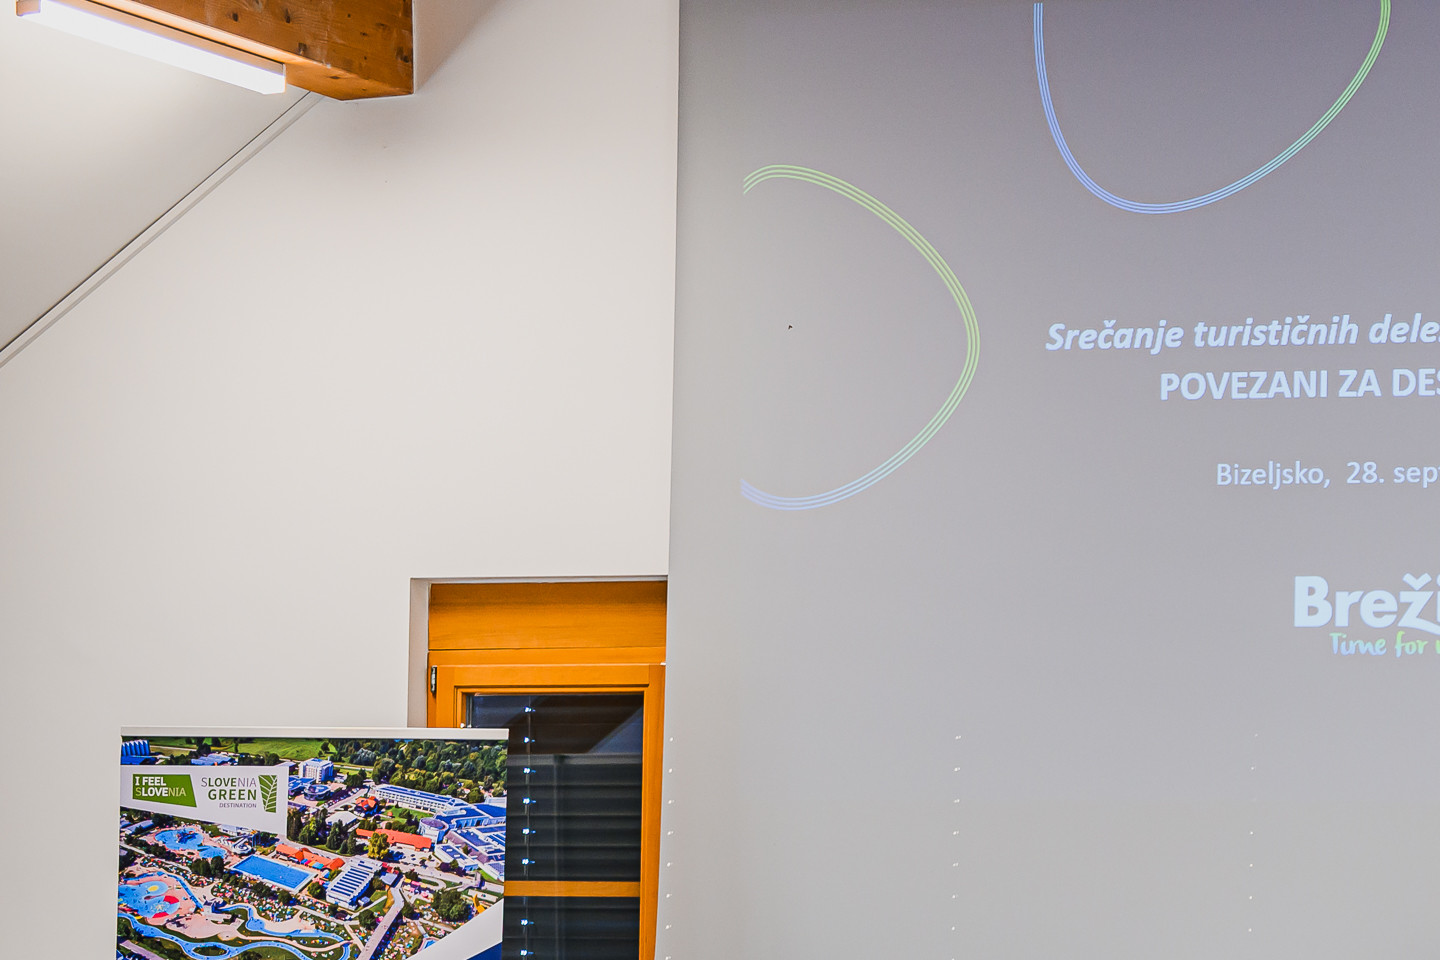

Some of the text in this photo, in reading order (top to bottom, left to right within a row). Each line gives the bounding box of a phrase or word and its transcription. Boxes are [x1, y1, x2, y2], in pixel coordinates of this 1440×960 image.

[1045, 319, 1185, 356] Srečanje
[1194, 314, 1360, 348] turističnih
[1159, 369, 1328, 401] POVEZANI
[1338, 368, 1382, 398] ZA
[1216, 460, 1332, 491] Bizeljsko,
[1345, 461, 1385, 485] 28.
[1329, 632, 1388, 656] Time
[1394, 630, 1429, 659] for
[135, 776, 167, 786] I FEEL
[201, 776, 257, 788] SLOVENIA
[135, 787, 187, 797] SLOVENIA
[208, 788, 257, 801] GREEN
